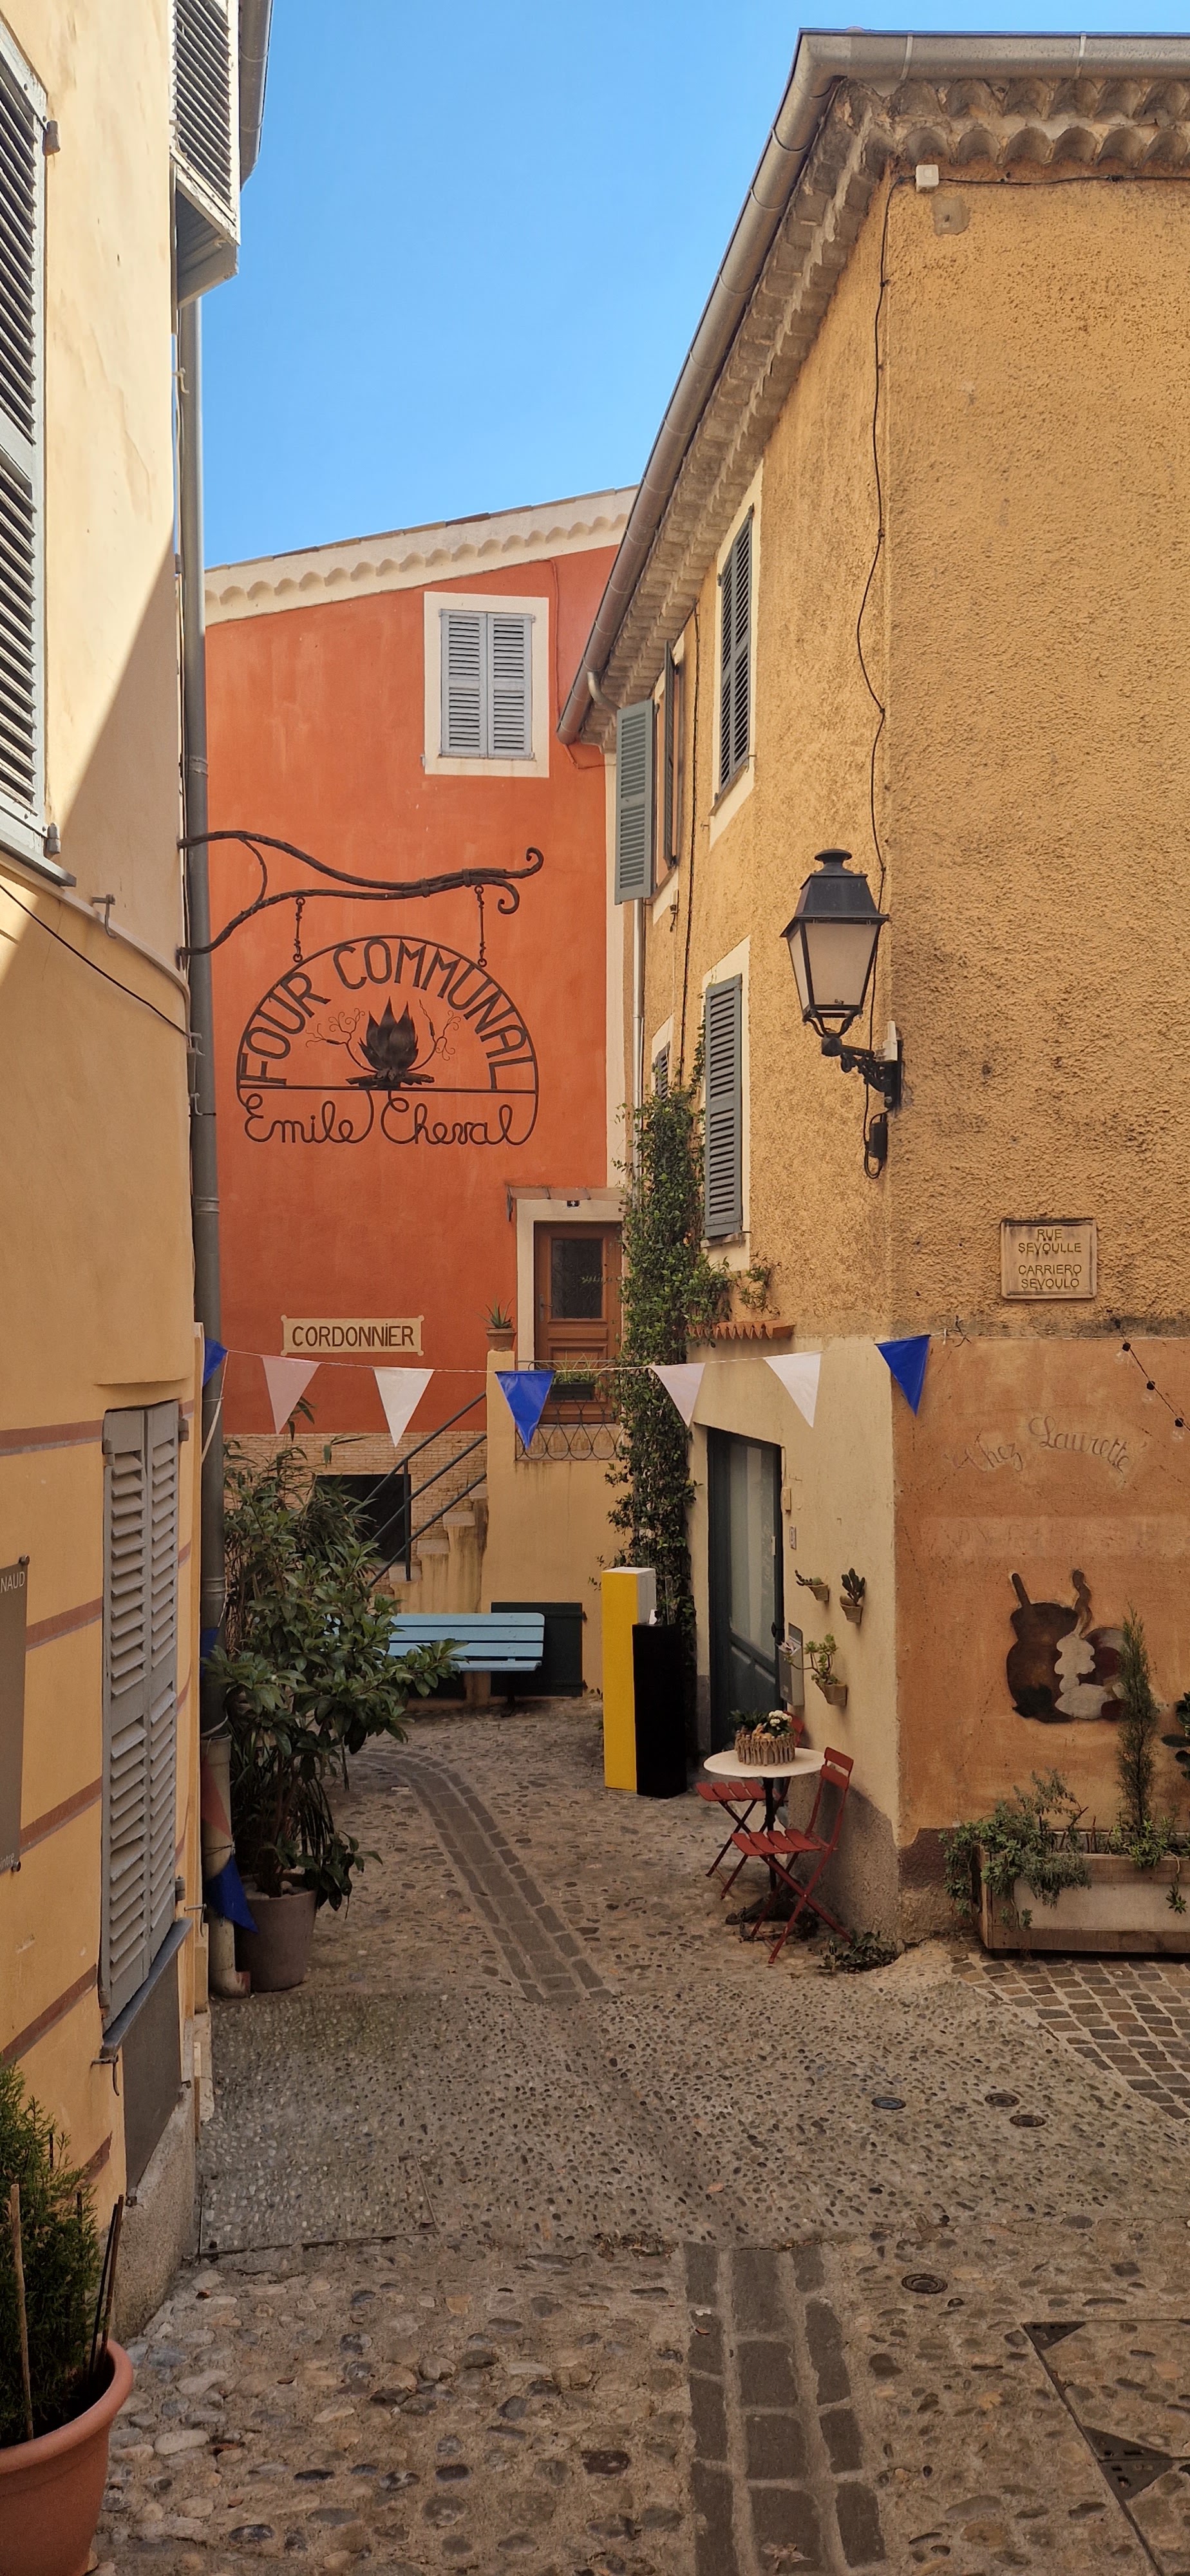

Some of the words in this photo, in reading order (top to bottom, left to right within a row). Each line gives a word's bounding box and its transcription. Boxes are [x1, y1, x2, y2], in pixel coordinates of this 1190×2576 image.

[240, 972, 332, 1086] FOUR
[333, 938, 534, 1090] COMMUNAL
[241, 1093, 374, 1143] Emile
[381, 1096, 538, 1144] Cheval
[1037, 1229, 1062, 1238] RUE
[1018, 1242, 1082, 1253] SEVOULLE
[1018, 1264, 1082, 1274] CARRIERO
[1021, 1278, 1080, 1289] SEVOULO
[1028, 1415, 1129, 1473] Laurette
[0, 1571, 25, 1594] NAUD
[0, 1852, 15, 1871] intre
